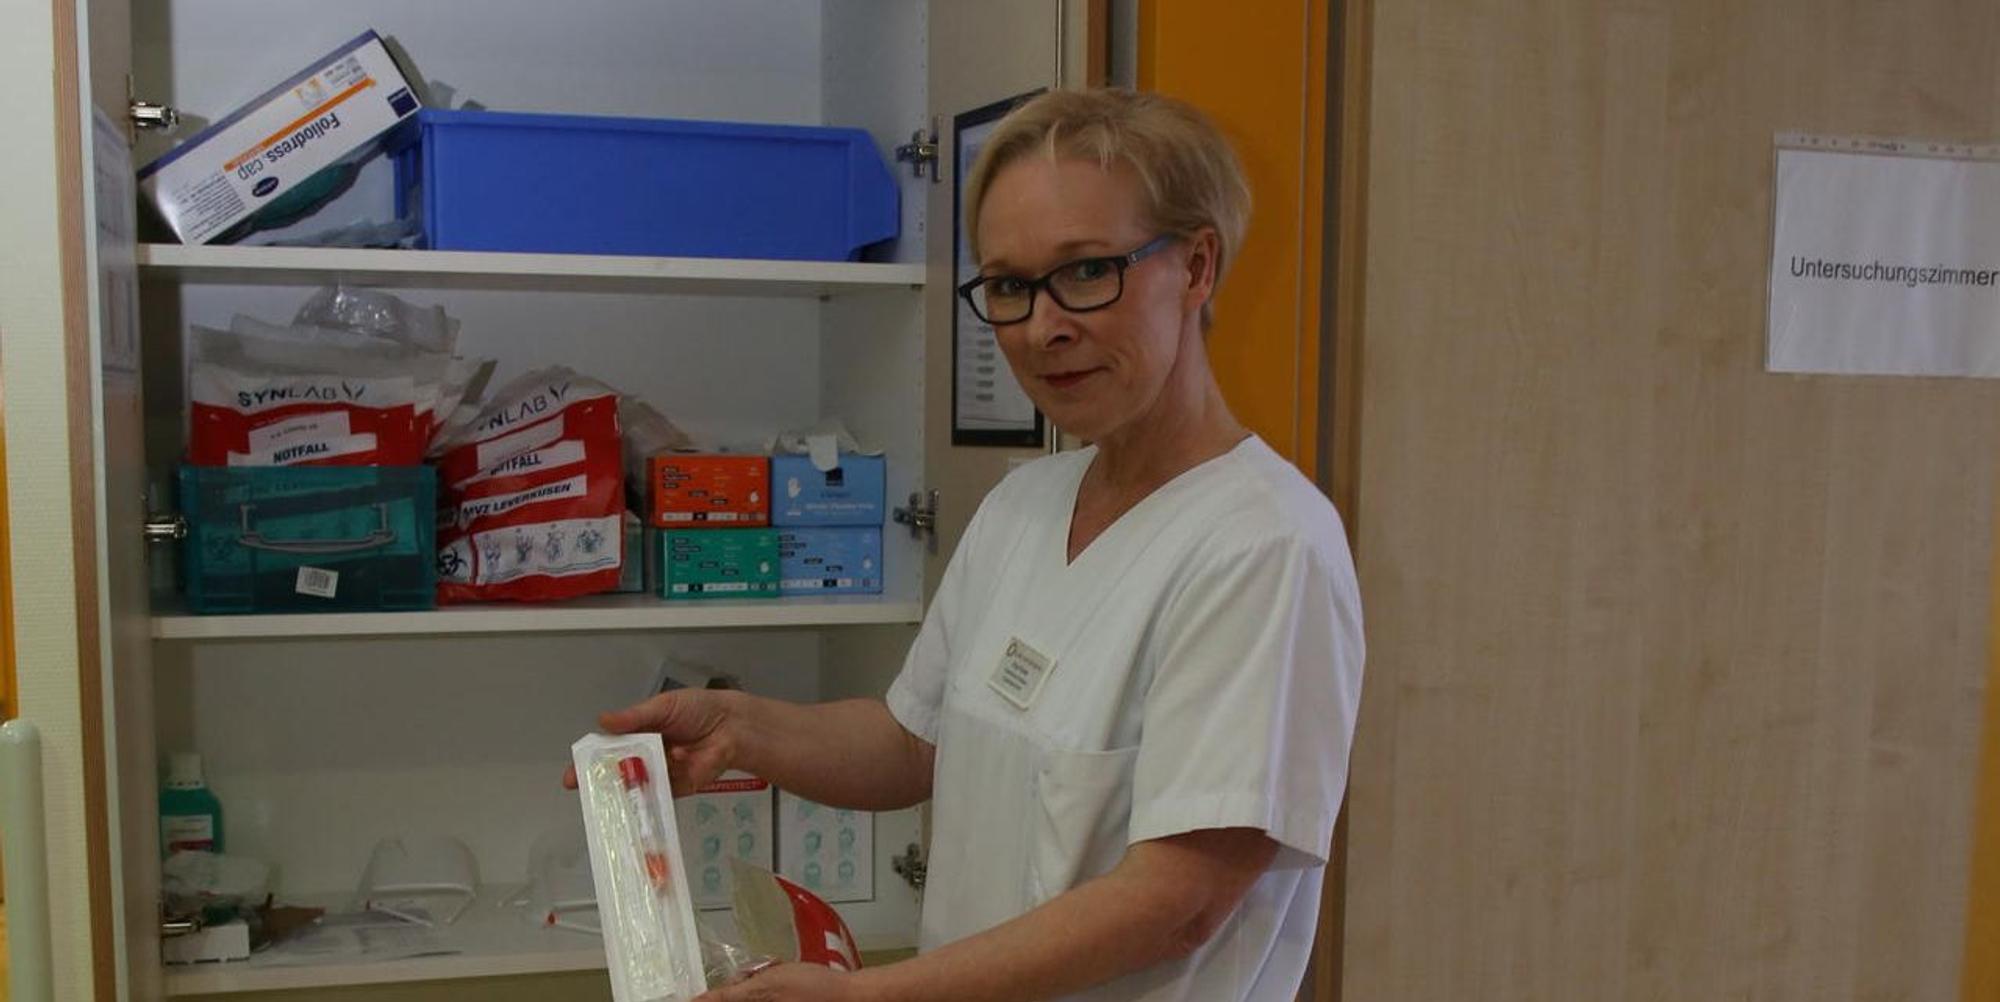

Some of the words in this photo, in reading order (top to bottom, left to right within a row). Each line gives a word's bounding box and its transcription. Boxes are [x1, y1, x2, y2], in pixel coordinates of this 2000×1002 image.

[266, 112, 340, 162] Foliodress
[238, 159, 263, 180] cap
[1790, 256, 1999, 287] Untersuchungszimmer
[238, 386, 337, 408] SYNLAB
[478, 395, 547, 431] NLAB
[273, 443, 330, 464] NOTFALL
[462, 502, 491, 517] MVZ
[493, 483, 571, 511] LEVERKUSEN
